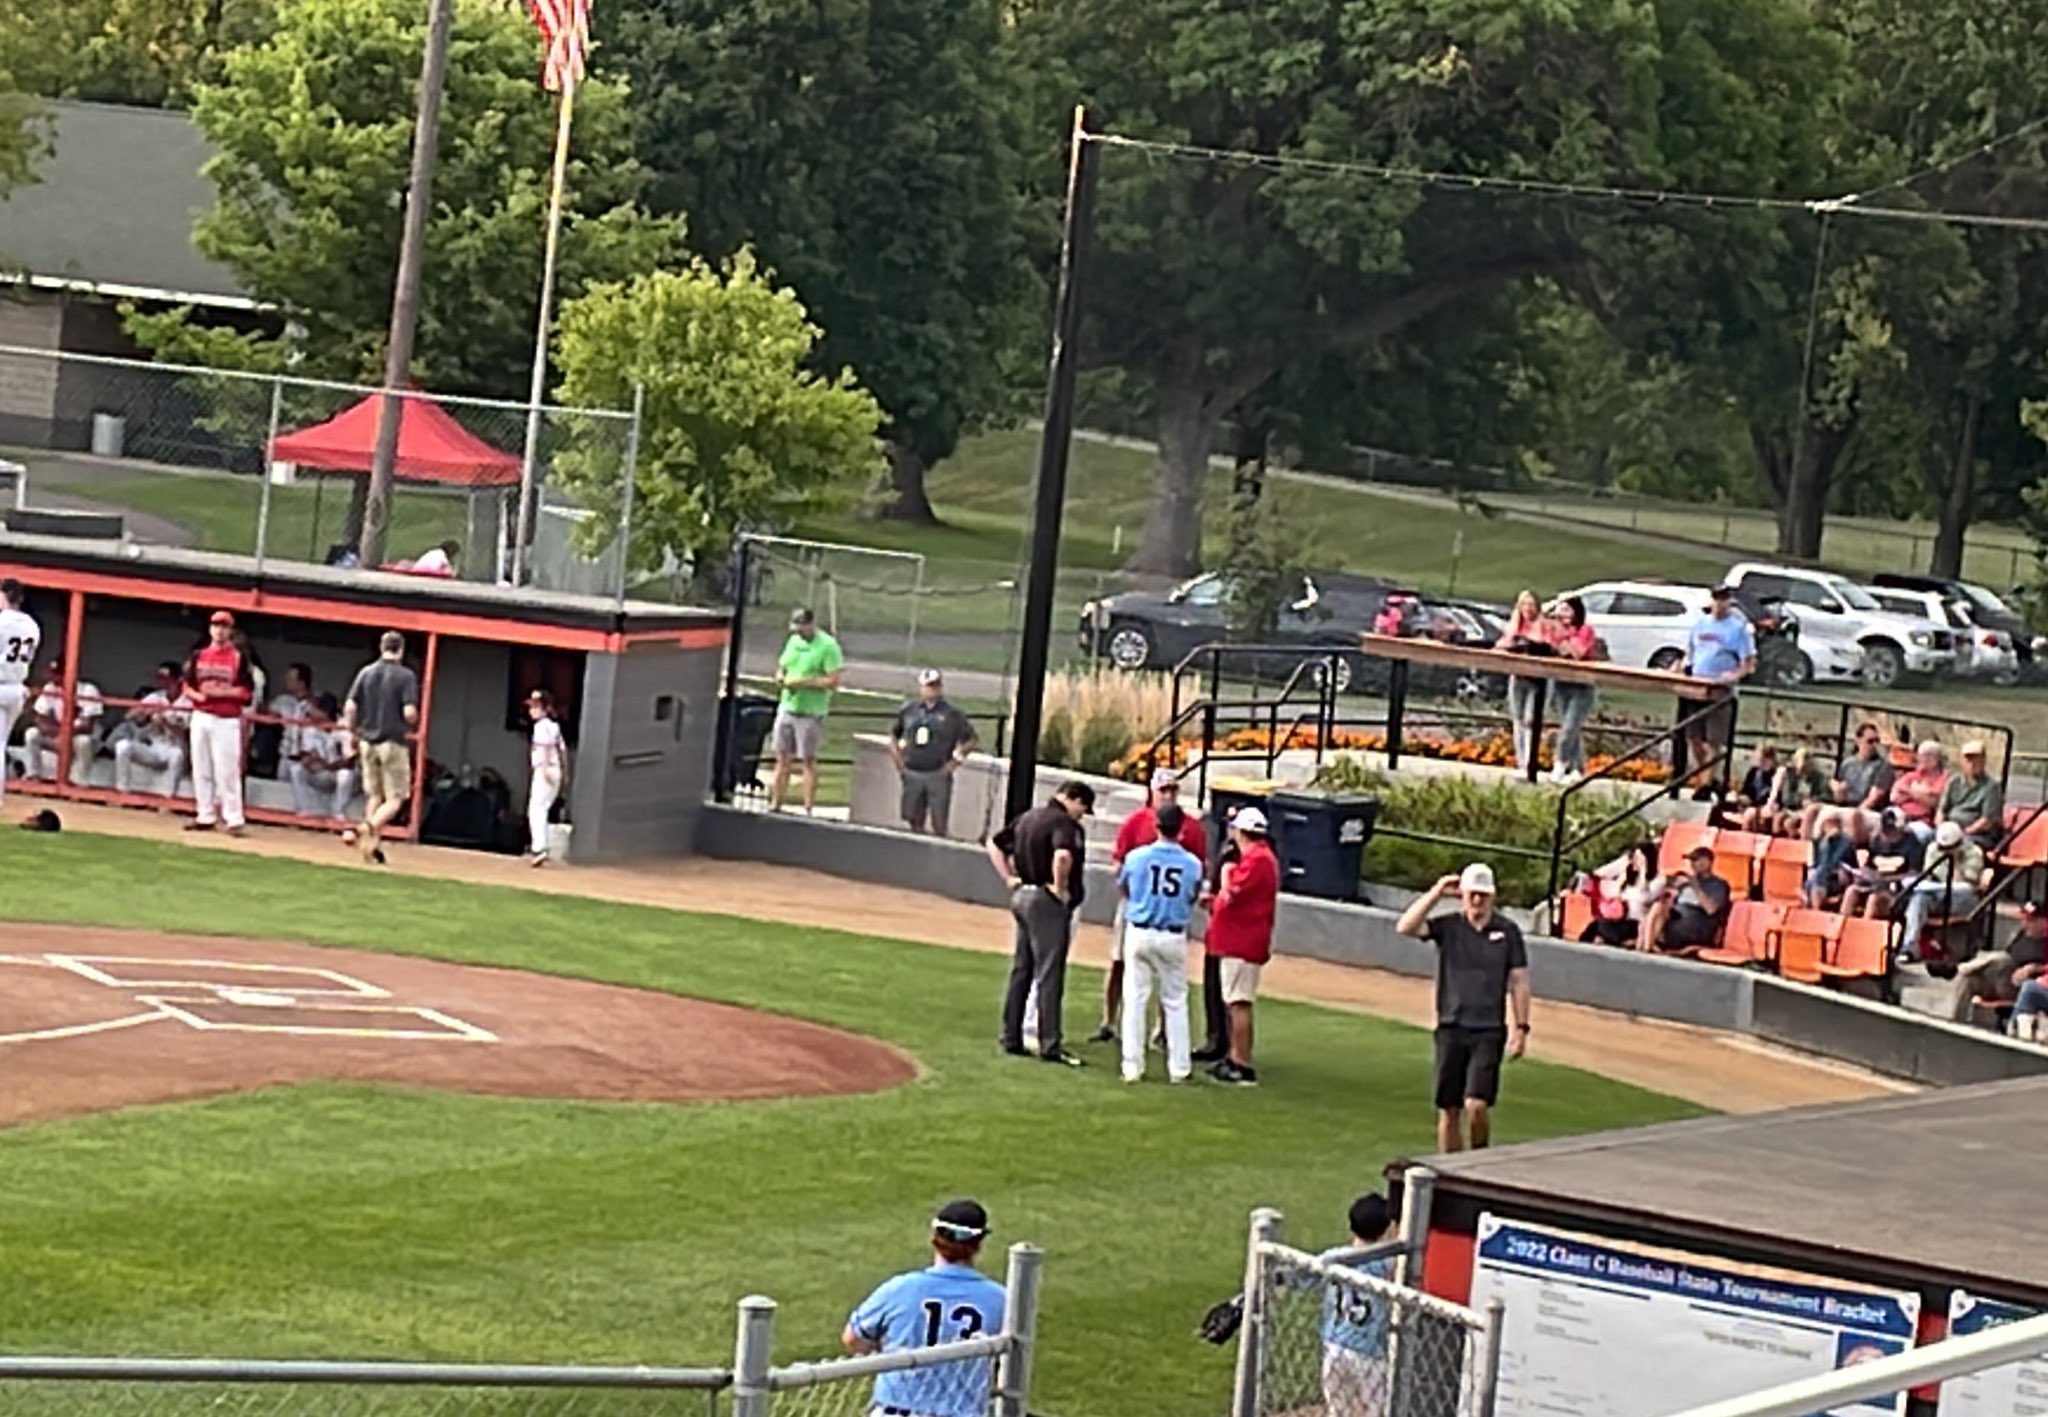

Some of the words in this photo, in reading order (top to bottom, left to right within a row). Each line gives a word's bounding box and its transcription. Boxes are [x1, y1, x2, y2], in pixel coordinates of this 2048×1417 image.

[1150, 864, 1184, 898] 15
[1506, 1235, 1547, 1263] 2022
[1593, 1253, 1606, 1273] C
[1677, 1269, 1719, 1295] State
[1721, 1276, 1821, 1313] Tournament
[1823, 1295, 1887, 1325] Bracket
